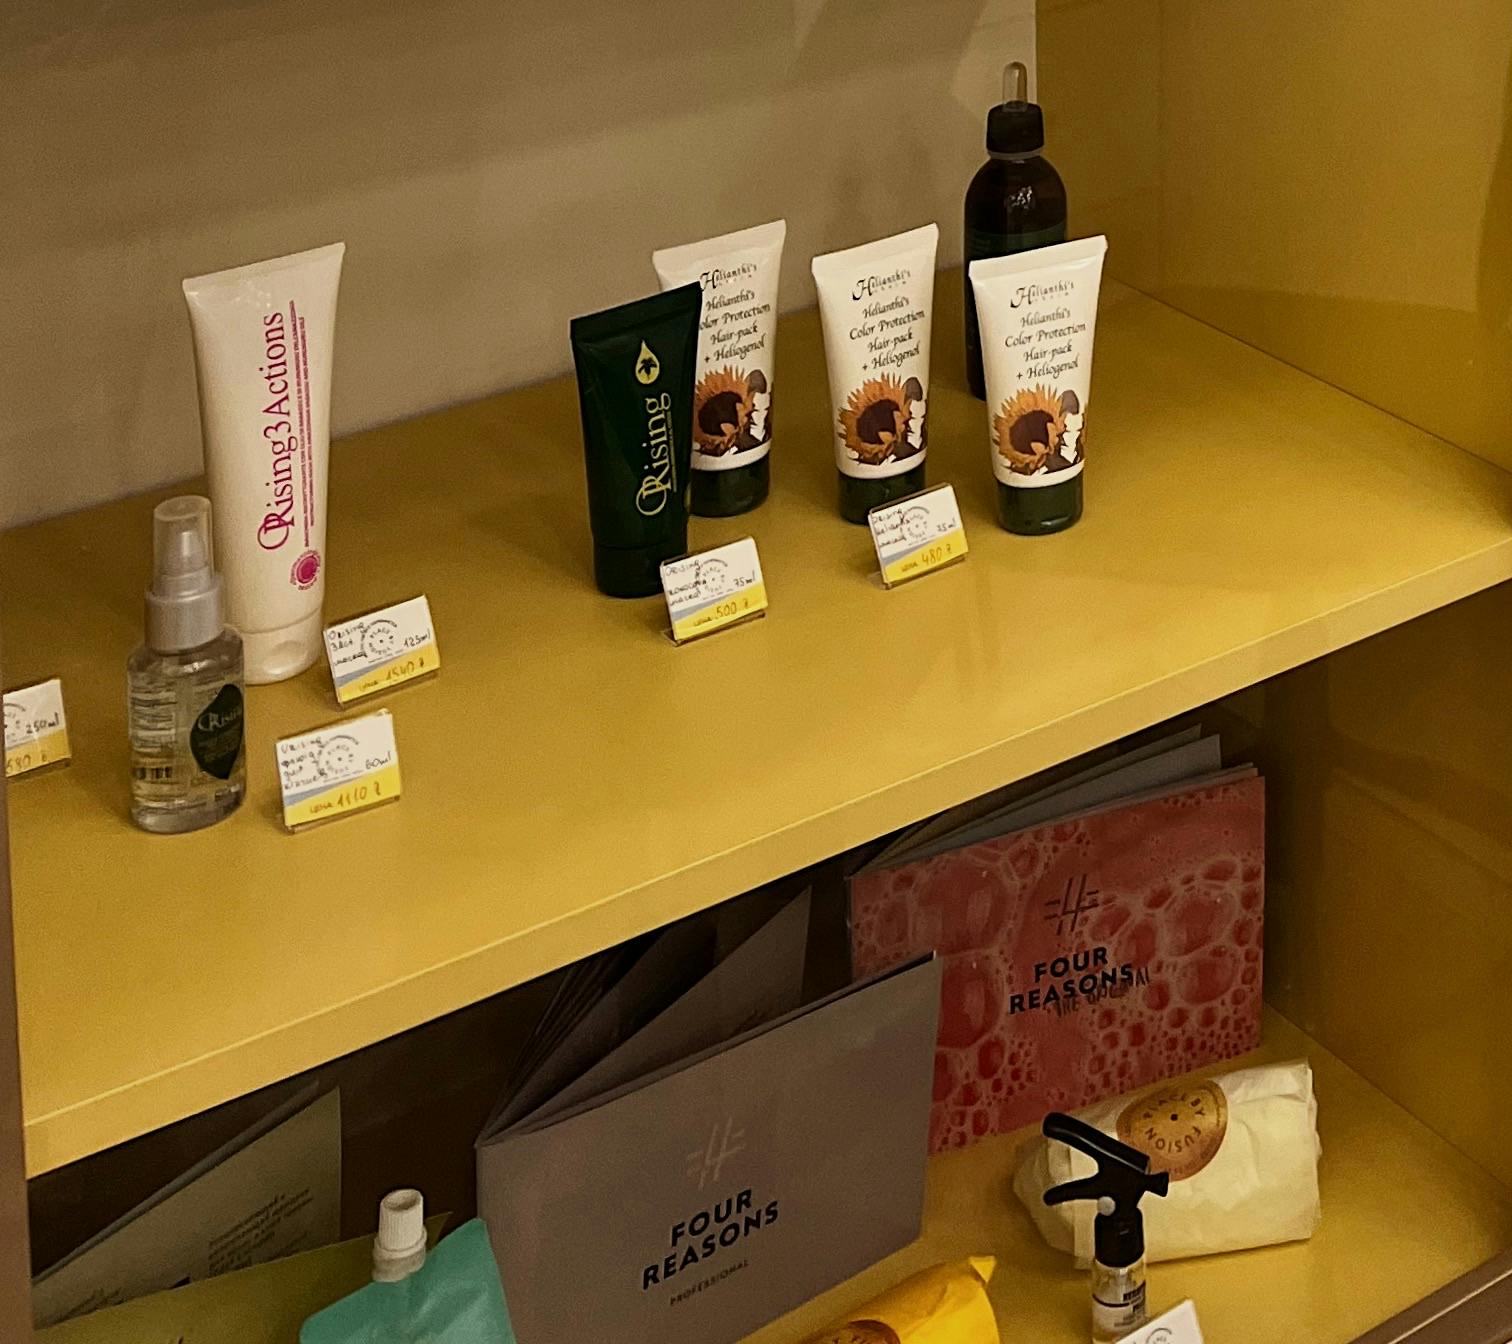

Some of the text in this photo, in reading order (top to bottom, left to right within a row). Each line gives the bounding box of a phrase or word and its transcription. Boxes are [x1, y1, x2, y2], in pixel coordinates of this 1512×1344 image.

[722, 303, 771, 324] Protection
[849, 310, 926, 340] Color Protection
[710, 319, 758, 345] Hair-pack
[868, 326, 913, 352] Hair-pack
[1004, 323, 1086, 348] Color Protection
[1023, 339, 1073, 362] Hair-pack
[921, 546, 943, 565] 480
[1034, 946, 1109, 984] FOUR
[1009, 963, 1135, 1015] REASONS
[1144, 1125, 1202, 1153] FUSION
[670, 1188, 753, 1248] FOUR
[642, 1200, 779, 1291] REASONS
